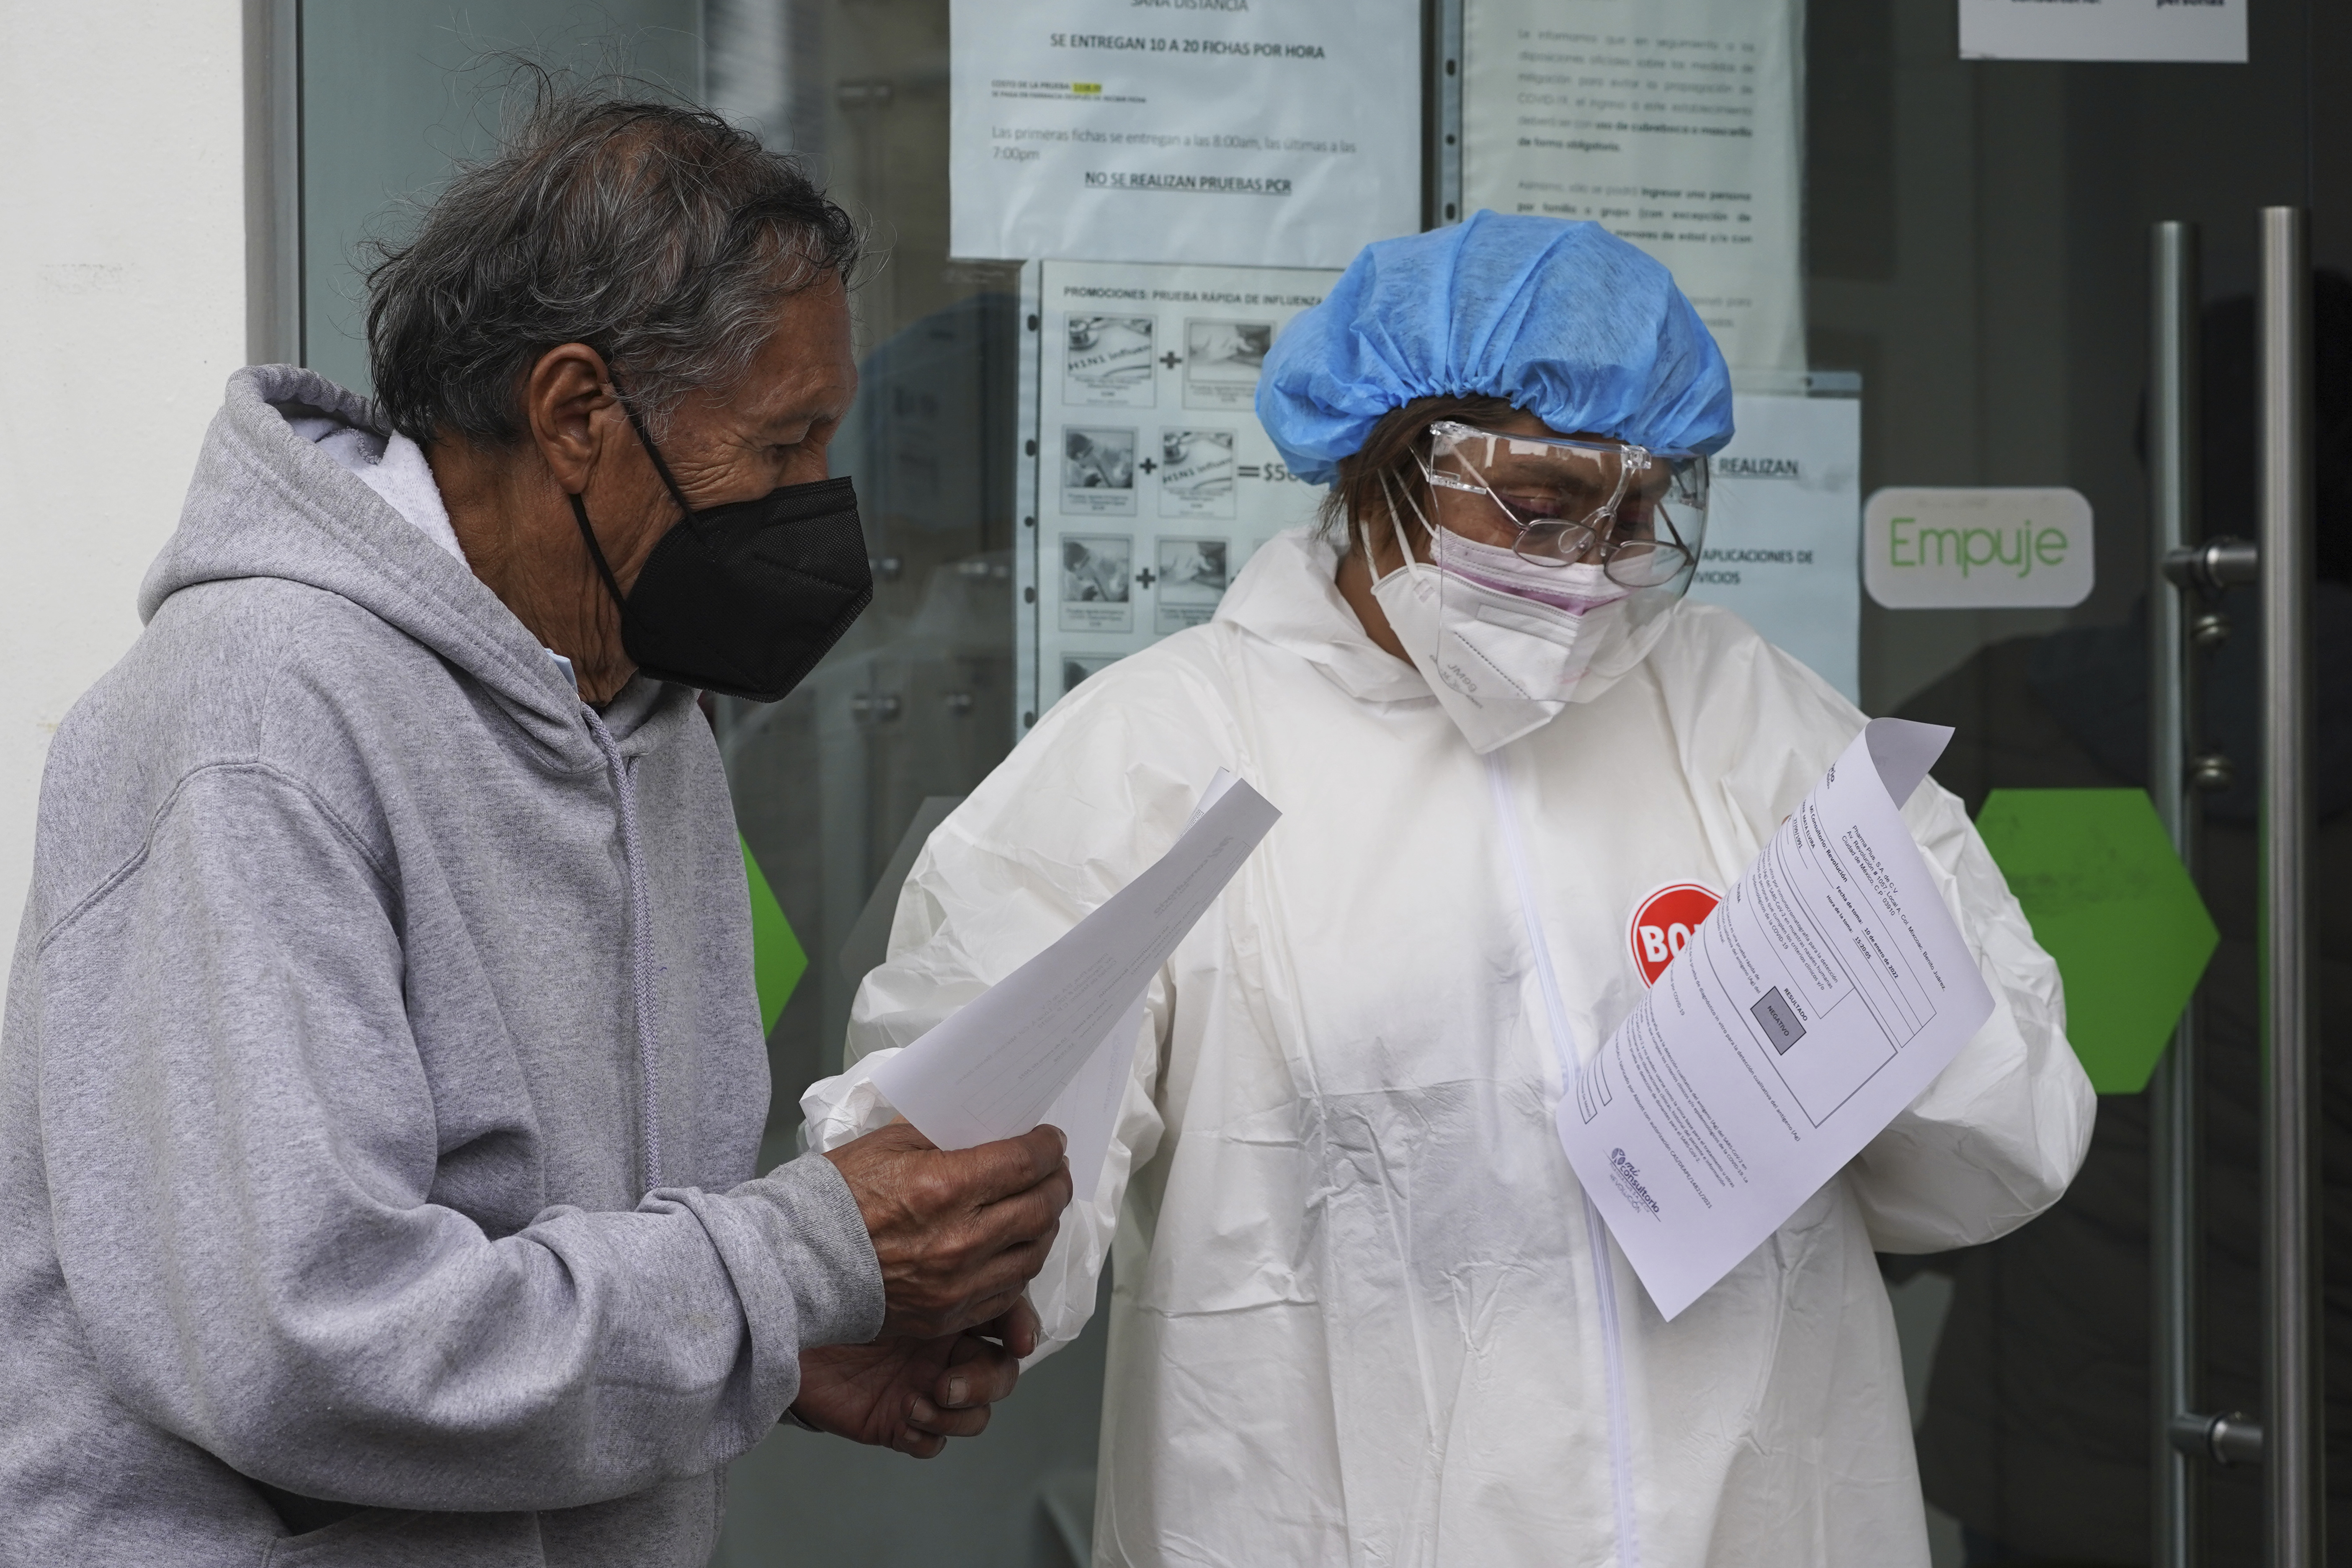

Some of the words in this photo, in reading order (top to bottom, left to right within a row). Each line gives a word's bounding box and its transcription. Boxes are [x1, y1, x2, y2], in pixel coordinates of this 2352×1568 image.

[1050, 33, 1067, 48] SE
[1070, 34, 1146, 50] ENTREGAN
[1149, 38, 1166, 52] 10
[1168, 39, 1180, 52] A
[1182, 39, 1200, 53] 20
[1202, 40, 1250, 57] FICHAS
[1253, 43, 1282, 58] POR
[1284, 44, 1326, 60] HORA
[992, 125, 1012, 139] Las
[1014, 127, 1070, 142] primeras
[1072, 127, 1107, 143] fichas
[1109, 132, 1122, 144] se
[1125, 133, 1181, 148] entregan
[1183, 136, 1192, 147] a
[1193, 134, 1211, 148] las
[1264, 136, 1281, 151] las
[1329, 141, 1338, 153] a
[1340, 139, 1357, 154] las
[992, 145, 1041, 162] 7:00pm
[1085, 171, 1107, 185] NO
[1110, 172, 1126, 186] SE
[1130, 172, 1196, 188] REALIZAN
[1199, 175, 1261, 191] PRUEBAS
[1265, 178, 1292, 193] PCR
[1064, 286, 1147, 300] PROMOCIONES:
[1152, 290, 1199, 303] PRUEBA
[1201, 290, 1241, 304] RÁPIDA
[1244, 294, 1259, 305] DE
[1719, 457, 1799, 475] REALIZAN
[1702, 548, 1794, 564] APLICACIONES
[1796, 549, 1814, 564] DE
[1890, 518, 2068, 578] Empuje
[1809, 805, 1814, 814] Mi
[1805, 830, 1815, 848] ELVIRA
[1811, 813, 1827, 849] Consultorio:
[1826, 849, 1847, 882] Revolución
[1842, 835, 1856, 856] Ciudad
[1859, 863, 1874, 885] México,
[1874, 885, 1883, 898] C.P.
[1882, 897, 1895, 916] 03910
[1852, 825, 1867, 848] Pharma
[1866, 847, 1875, 862] Plus,
[1875, 861, 1884, 873] S.A.
[1889, 882, 1898, 893] C.V.
[1758, 880, 1769, 902] personas
[1772, 913, 1787, 934] cumplen
[1791, 942, 1805, 963] criterios
[1804, 962, 1818, 981] clínicos
[1826, 895, 1835, 907] Hora
[1842, 918, 1853, 933] toma:
[1854, 936, 1871, 959] 15:20:05
[1836, 886, 1847, 901] Fecha
[1851, 908, 1863, 924] toma:
[1874, 942, 1885, 958] enero
[1888, 965, 1898, 978] 2022
[1853, 840, 1874, 871] Revolución
[1877, 876, 1887, 892] 1057,
[1886, 891, 1898, 908] Local
[1901, 914, 1909, 926] Col.
[1908, 926, 1923, 952] Mixcoac,
[1922, 951, 1934, 970] Benito
[1933, 971, 1945, 991] Juárez,
[1639, 922, 1702, 962] BO
[1736, 942, 1746, 959] prueba
[1769, 887, 1786, 917] SARS-CoV-2
[1788, 924, 1805, 948] muestras
[1803, 947, 1817, 966] nasales
[1816, 965, 1833, 989] humanas
[1772, 925, 1788, 949] COVID-19
[1777, 888, 1810, 941] inmunocromatografía
[1808, 941, 1818, 953] para
[1820, 959, 1838, 983] detección
[1747, 975, 1756, 986] (Ag)
[1673, 991, 1685, 1016] COVID-19
[1767, 1005, 1789, 1036] NEGATIVO
[1784, 988, 1808, 1021] RESULTADO
[1699, 988, 1716, 1016] diagnóstico
[1718, 1021, 1727, 1034] vitro
[1725, 1034, 1735, 1046] para
[1737, 1051, 1754, 1075] detección
[1753, 1075, 1772, 1100] cualitativa
[1776, 1109, 1792, 1130] antígeno
[1791, 1130, 1800, 1142] (Ag)
[1665, 1063, 1678, 1082] criterios
[1694, 1107, 1719, 1143] epidemiológicos
[1632, 1093, 1645, 1112] Abbott
[1670, 1150, 1712, 1209] CAS/DEAPE/14821/2021
[1710, 1119, 1719, 1130] (Ag)
[1723, 1137, 1743, 1163] SARS-CoV-2
[1625, 1162, 1640, 1176] mi
[1703, 1145, 1723, 1172] tratamiento
[1725, 1175, 1734, 1188] otras
[1620, 1166, 1659, 1212] consultorio
